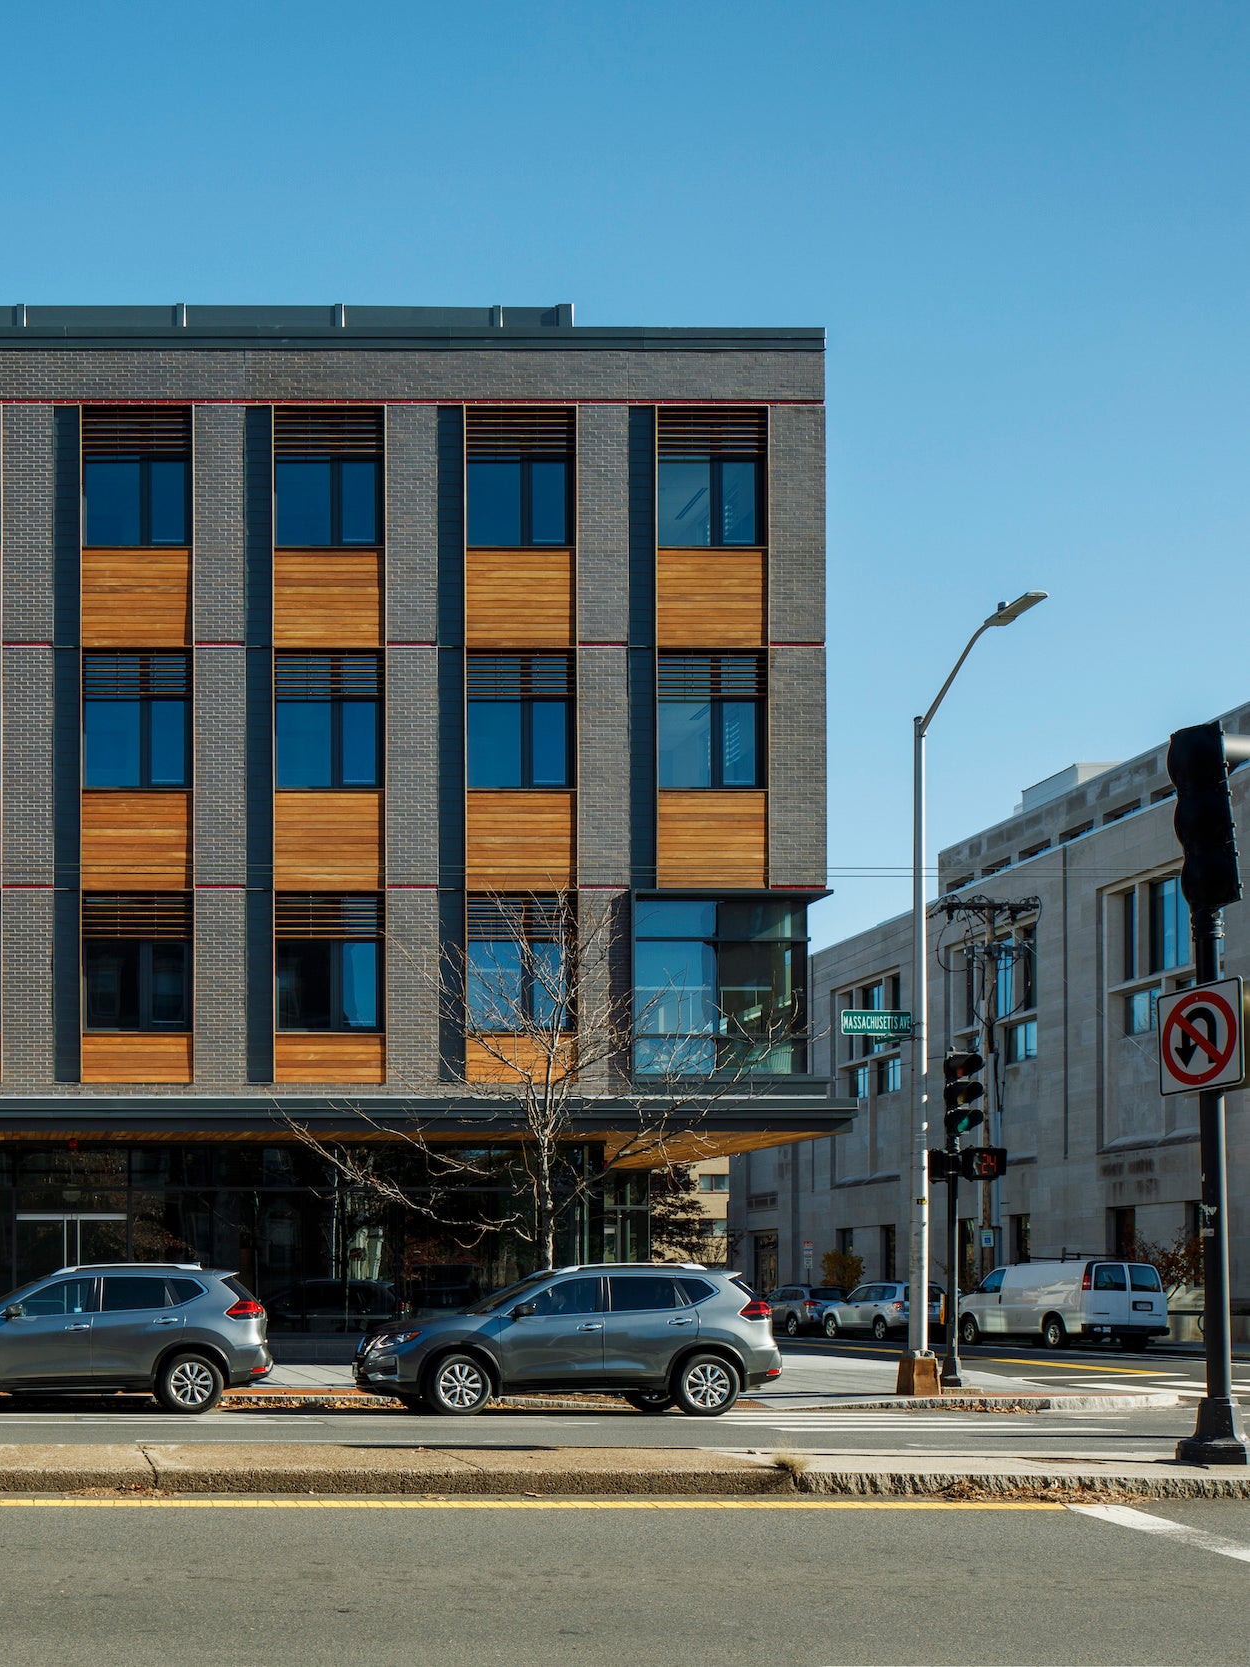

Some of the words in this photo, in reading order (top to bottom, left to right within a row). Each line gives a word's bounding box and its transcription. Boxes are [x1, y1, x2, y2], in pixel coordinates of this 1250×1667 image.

[843, 1015, 898, 1030] MASSACHUSETTS
[899, 1015, 911, 1030] AVE
[981, 1153, 997, 1174] 24
